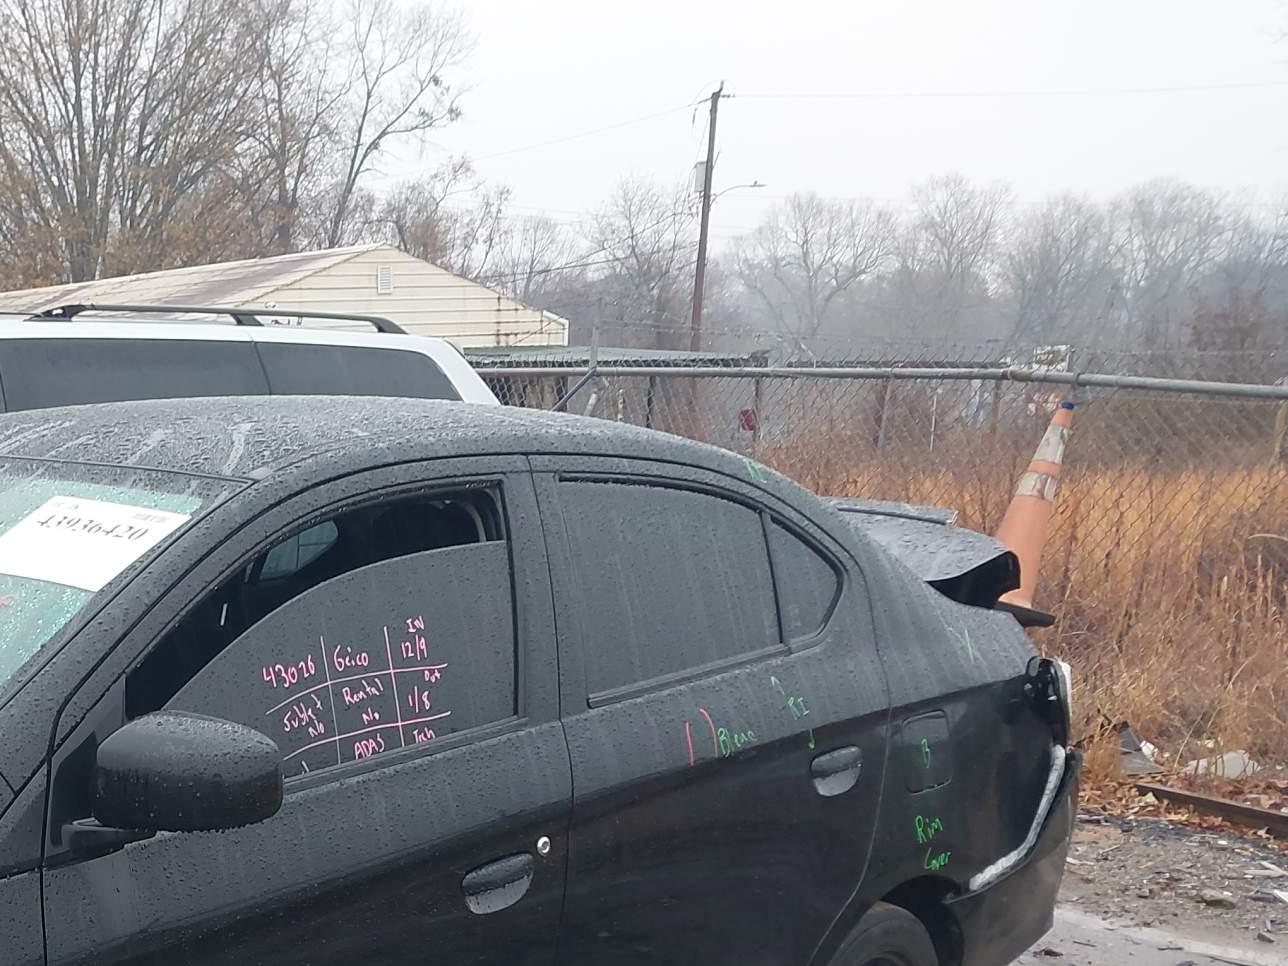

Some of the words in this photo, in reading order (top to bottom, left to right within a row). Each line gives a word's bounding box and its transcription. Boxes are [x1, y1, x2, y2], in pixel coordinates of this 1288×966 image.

[37, 513, 150, 541] 43936420
[333, 644, 369, 672] Geico
[400, 634, 428, 661] 12/9
[262, 654, 316, 688] 43026
[408, 686, 431, 713] 1/8
[354, 733, 385, 760] ADAS
[915, 815, 944, 844] Rim
